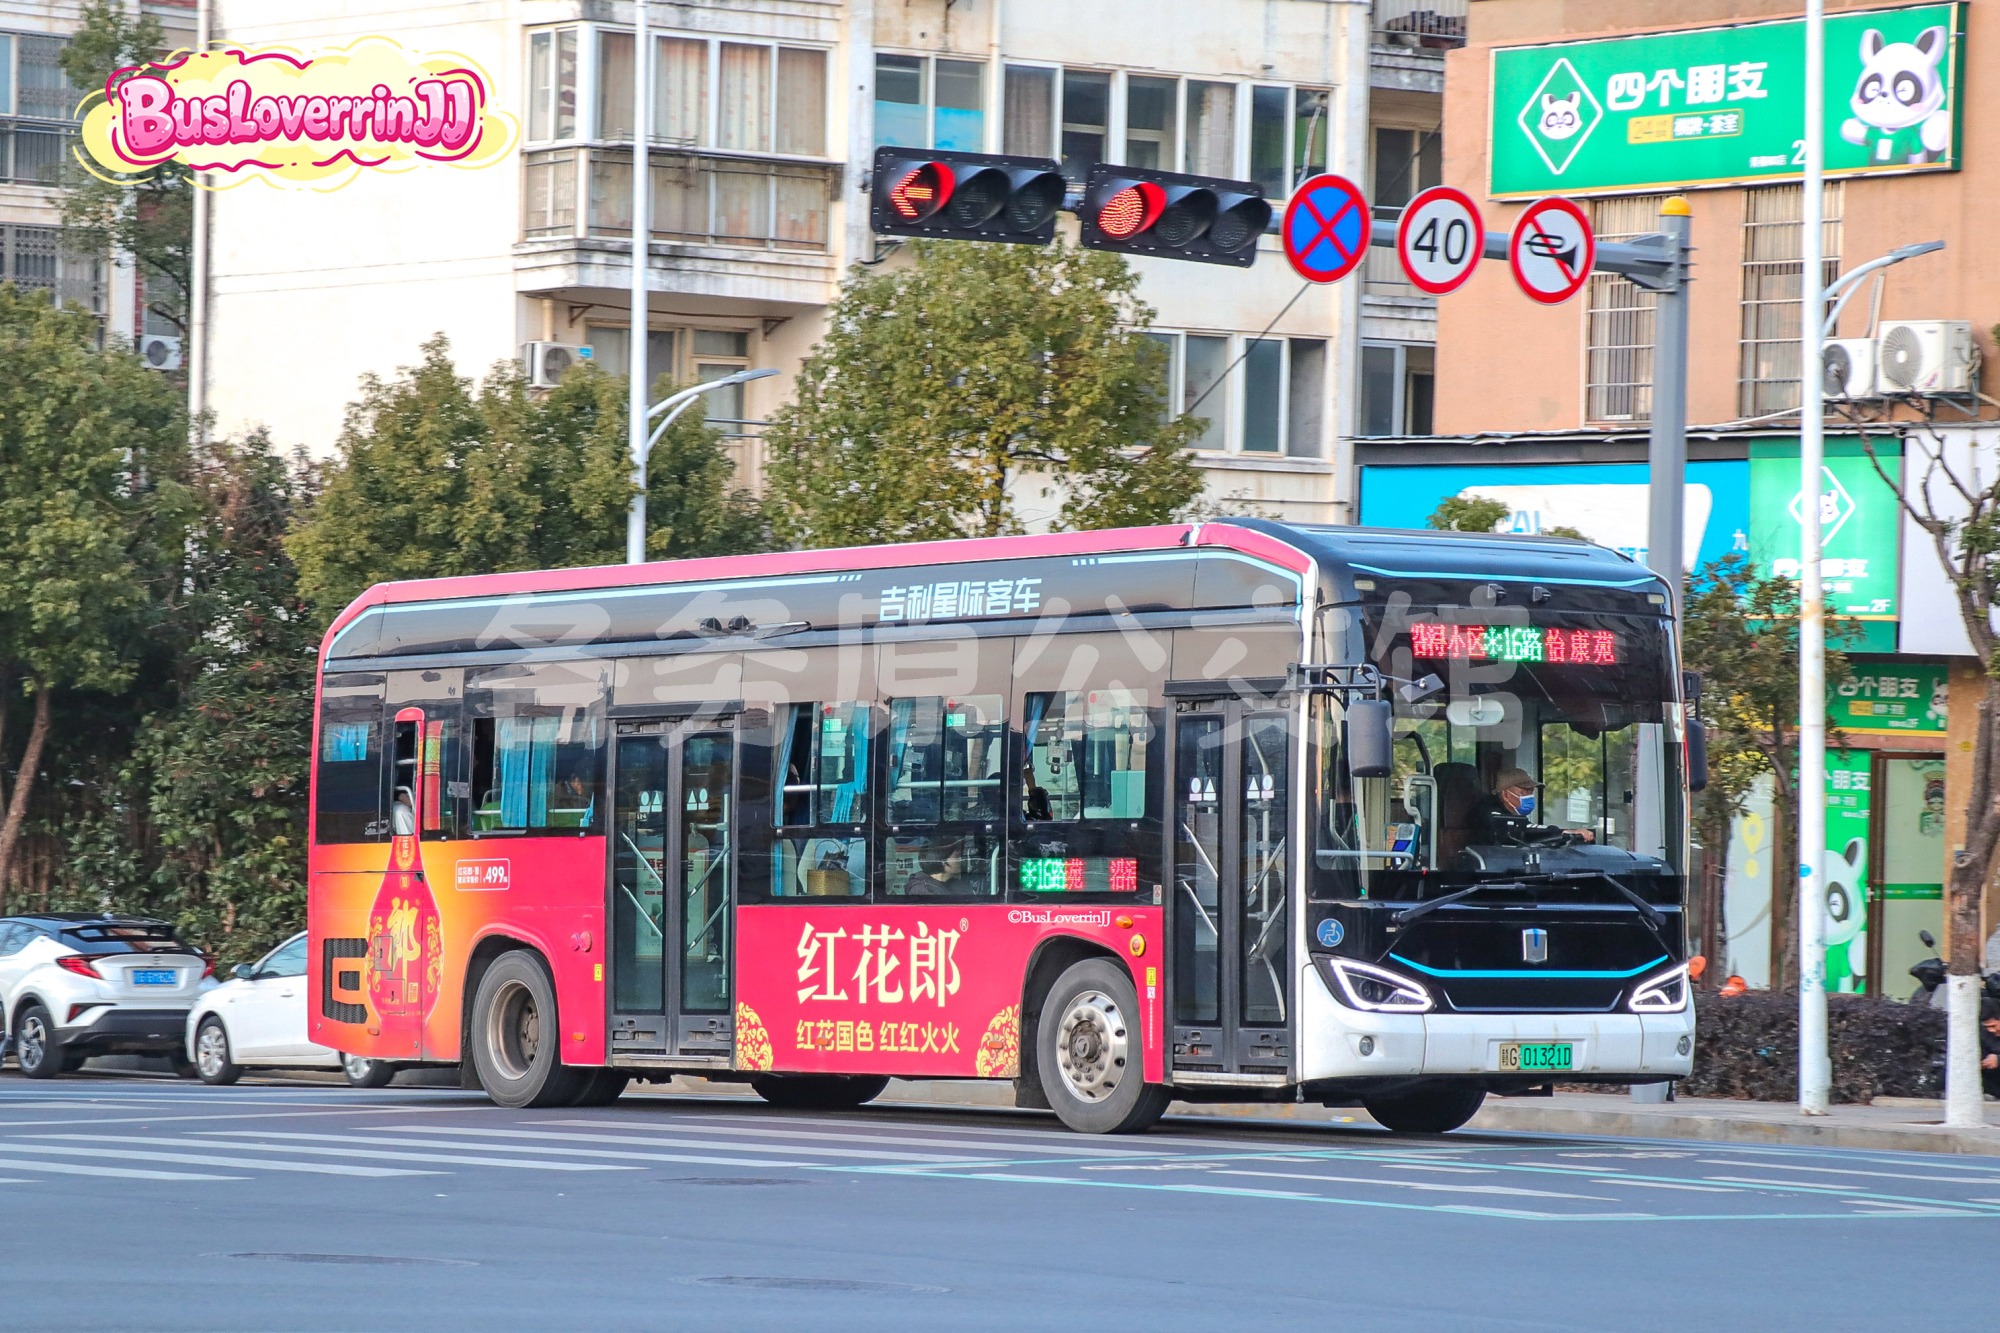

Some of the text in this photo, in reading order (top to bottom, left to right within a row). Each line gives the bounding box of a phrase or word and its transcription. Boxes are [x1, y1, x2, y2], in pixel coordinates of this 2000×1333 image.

[1413, 217, 1468, 265] 40
[879, 577, 1043, 622] 吉利星际客车
[796, 920, 961, 1008] 红花郎
[796, 1019, 960, 1054] 红花国色 红红火火
